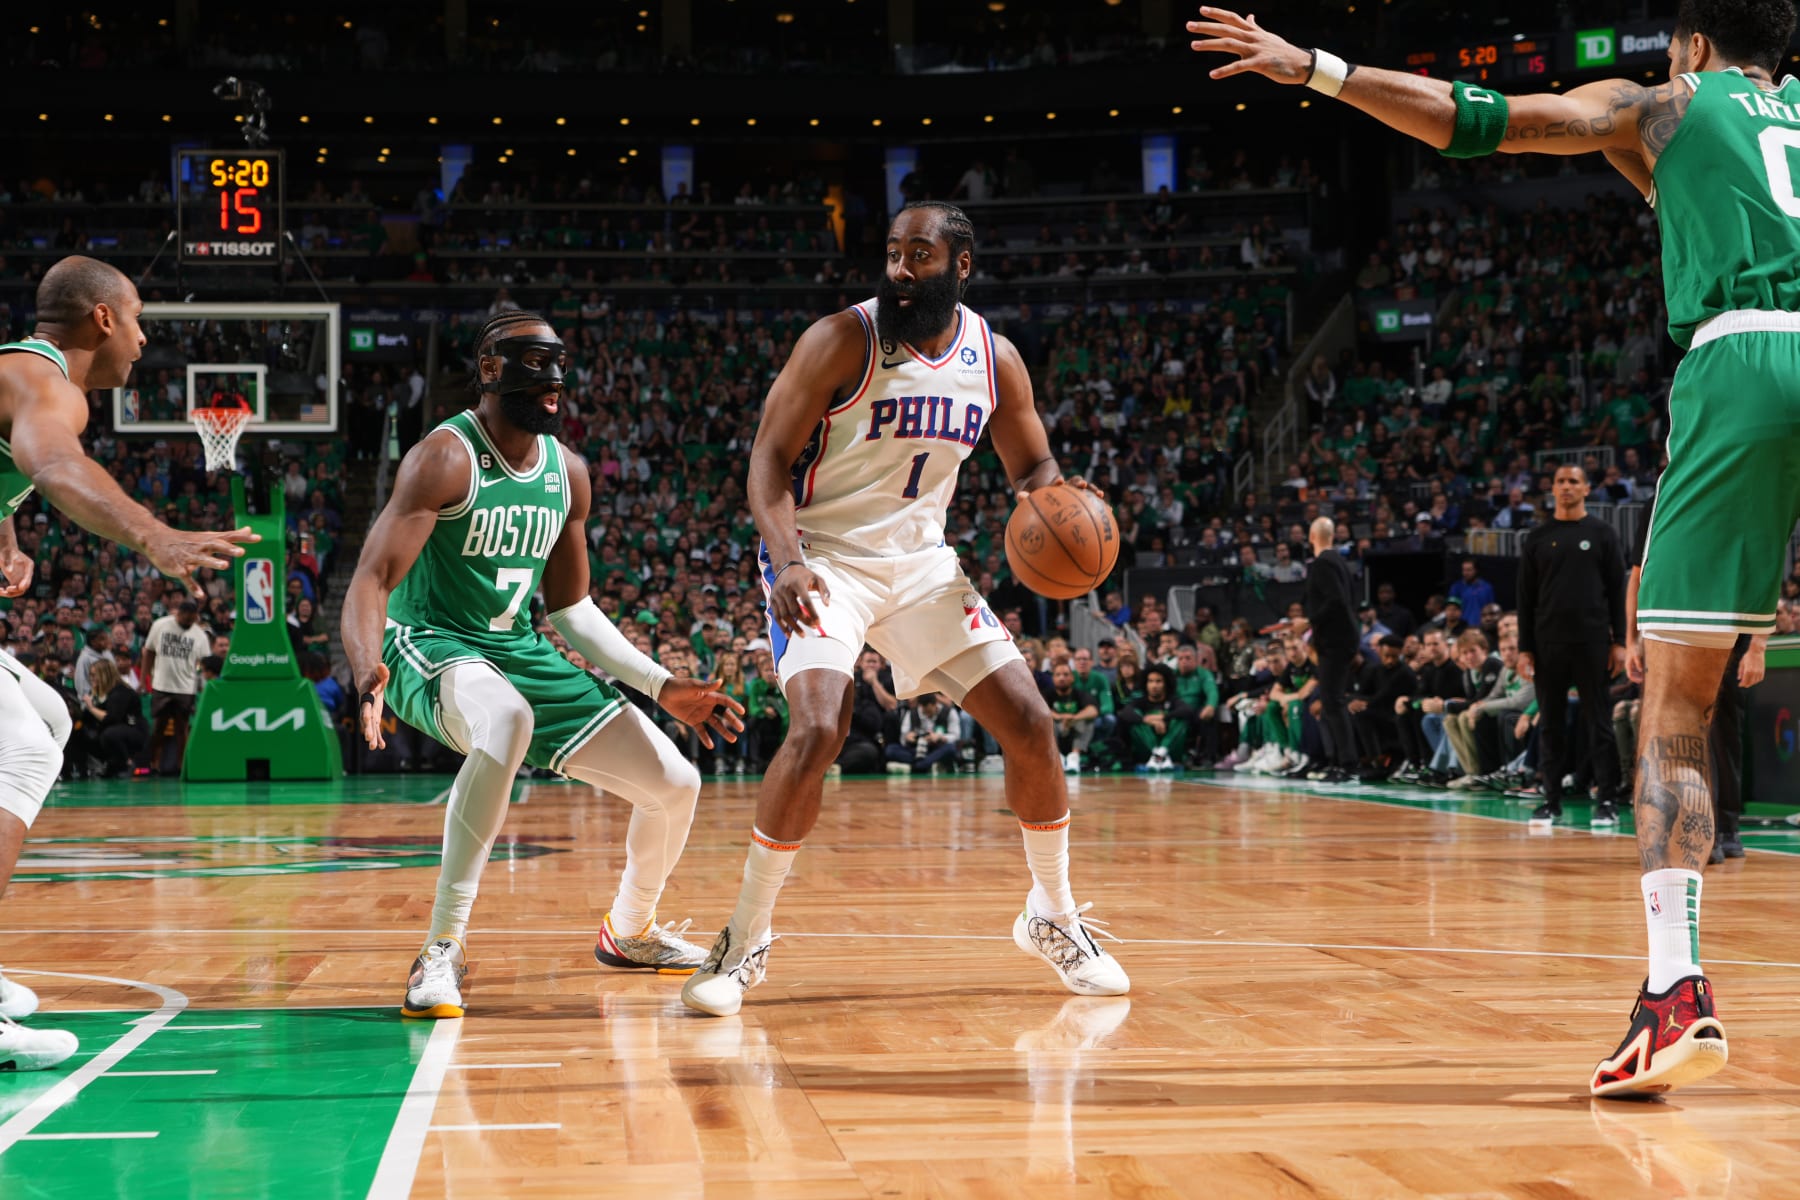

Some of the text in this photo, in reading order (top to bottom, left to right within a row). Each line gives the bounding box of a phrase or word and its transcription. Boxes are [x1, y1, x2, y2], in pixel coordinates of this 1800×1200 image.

[1580, 30, 1670, 60] TD Bank
[1529, 56, 1546, 74] 15
[211, 159, 269, 187] 5:20
[221, 188, 262, 234] 15
[210, 242, 276, 256] TISSOT
[866, 396, 983, 449] PHILA
[480, 454, 492, 469] 6
[902, 452, 930, 499] 1
[544, 472, 560, 484] VISTA
[544, 484, 561, 494] PRINT
[461, 505, 563, 560] BOSTON
[489, 567, 535, 632] 7
[229, 653, 289, 667] Google Pixel
